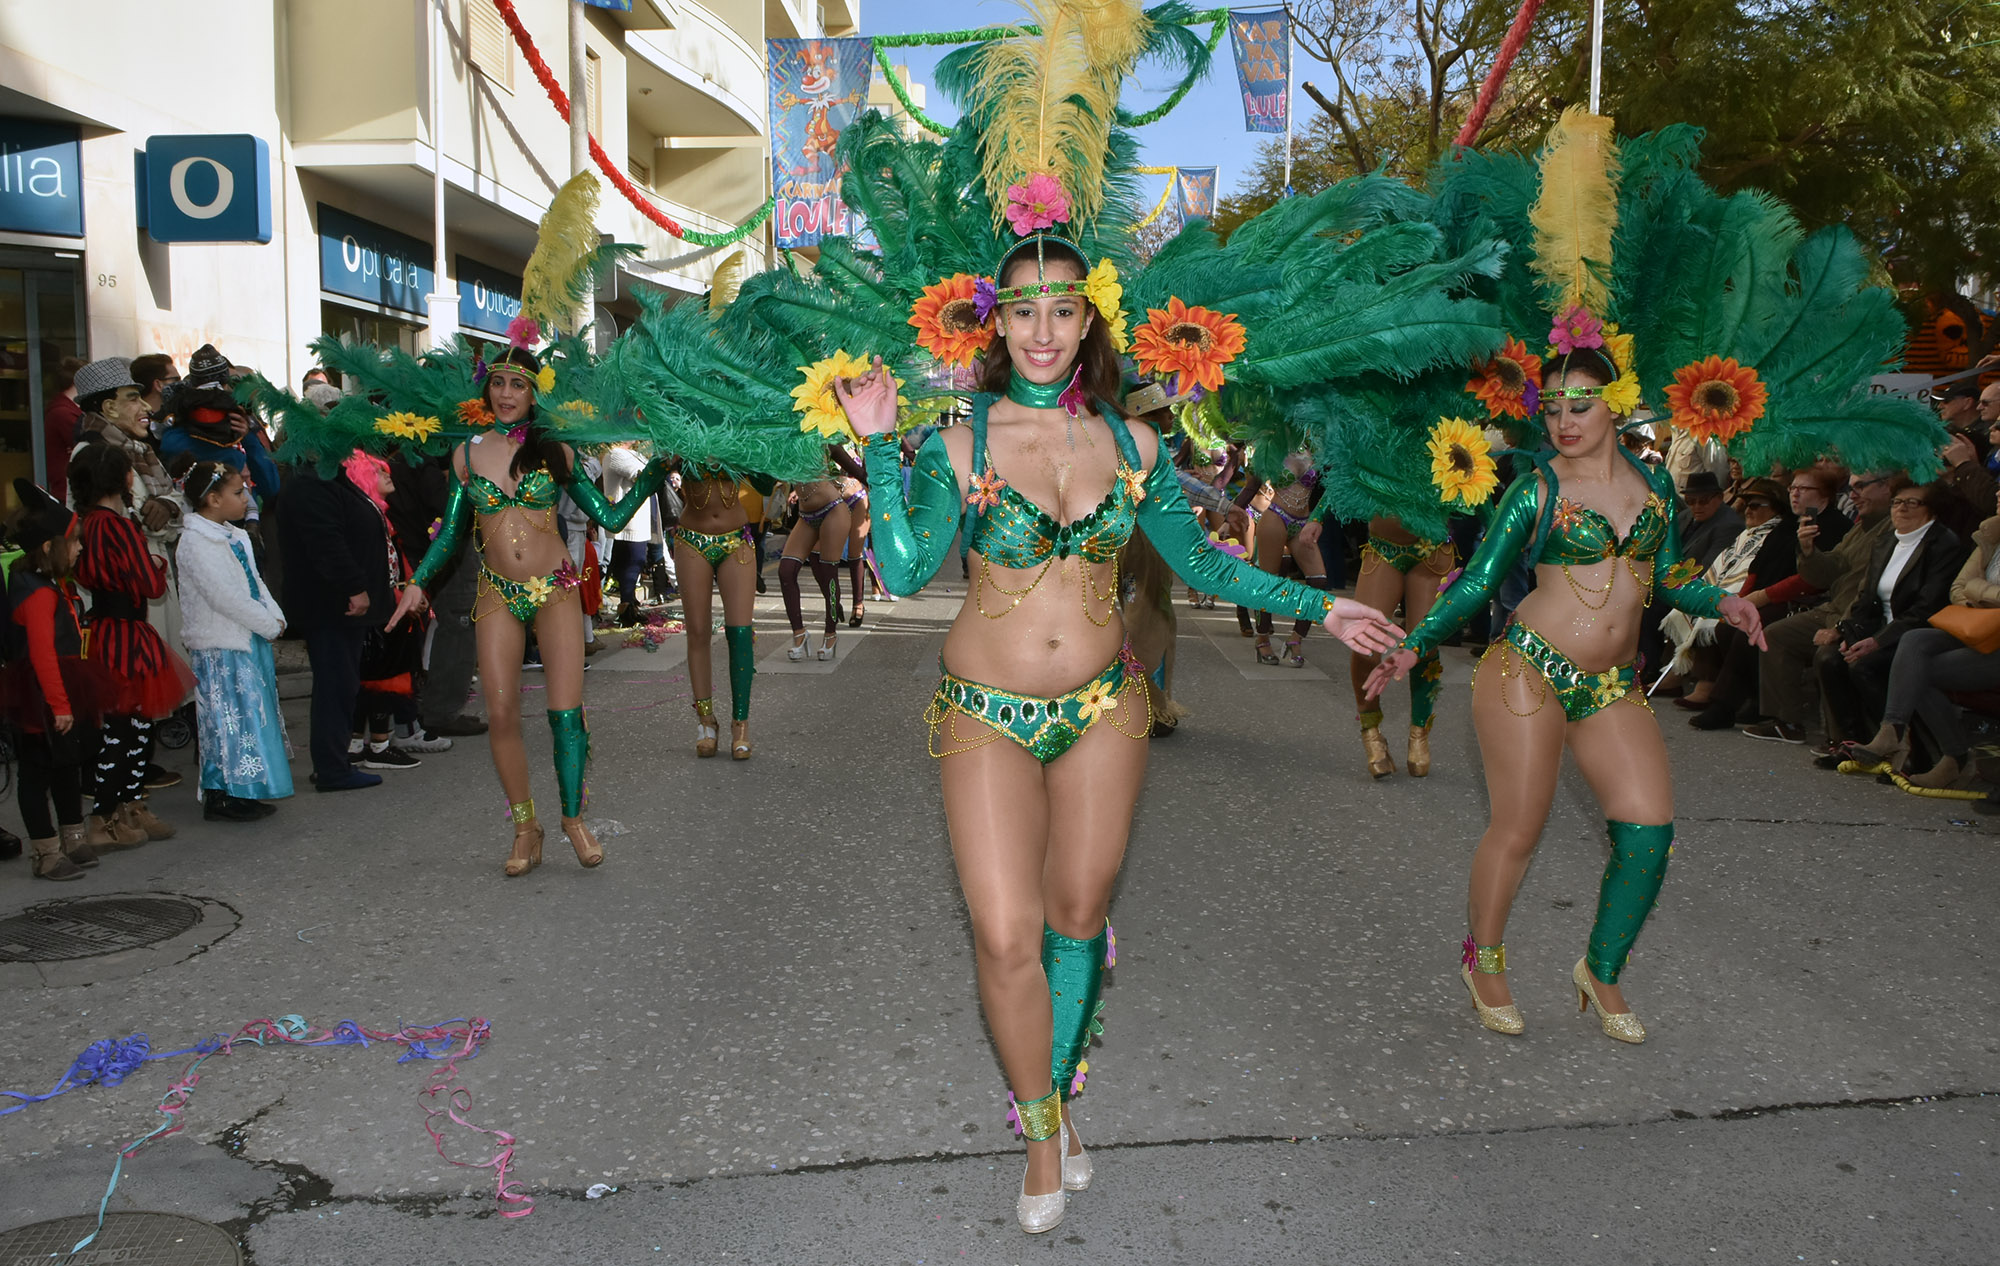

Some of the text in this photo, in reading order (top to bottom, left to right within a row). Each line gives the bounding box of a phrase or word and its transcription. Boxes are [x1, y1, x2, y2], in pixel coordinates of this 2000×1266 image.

[1237, 20, 1281, 43] CAR
[1244, 42, 1279, 62] NA
[1242, 60, 1287, 83] VAL
[0, 142, 67, 198] lia
[169, 156, 234, 219] O
[1182, 174, 1211, 190] CAR
[342, 234, 419, 289] Opticália
[97, 273, 117, 288] 95
